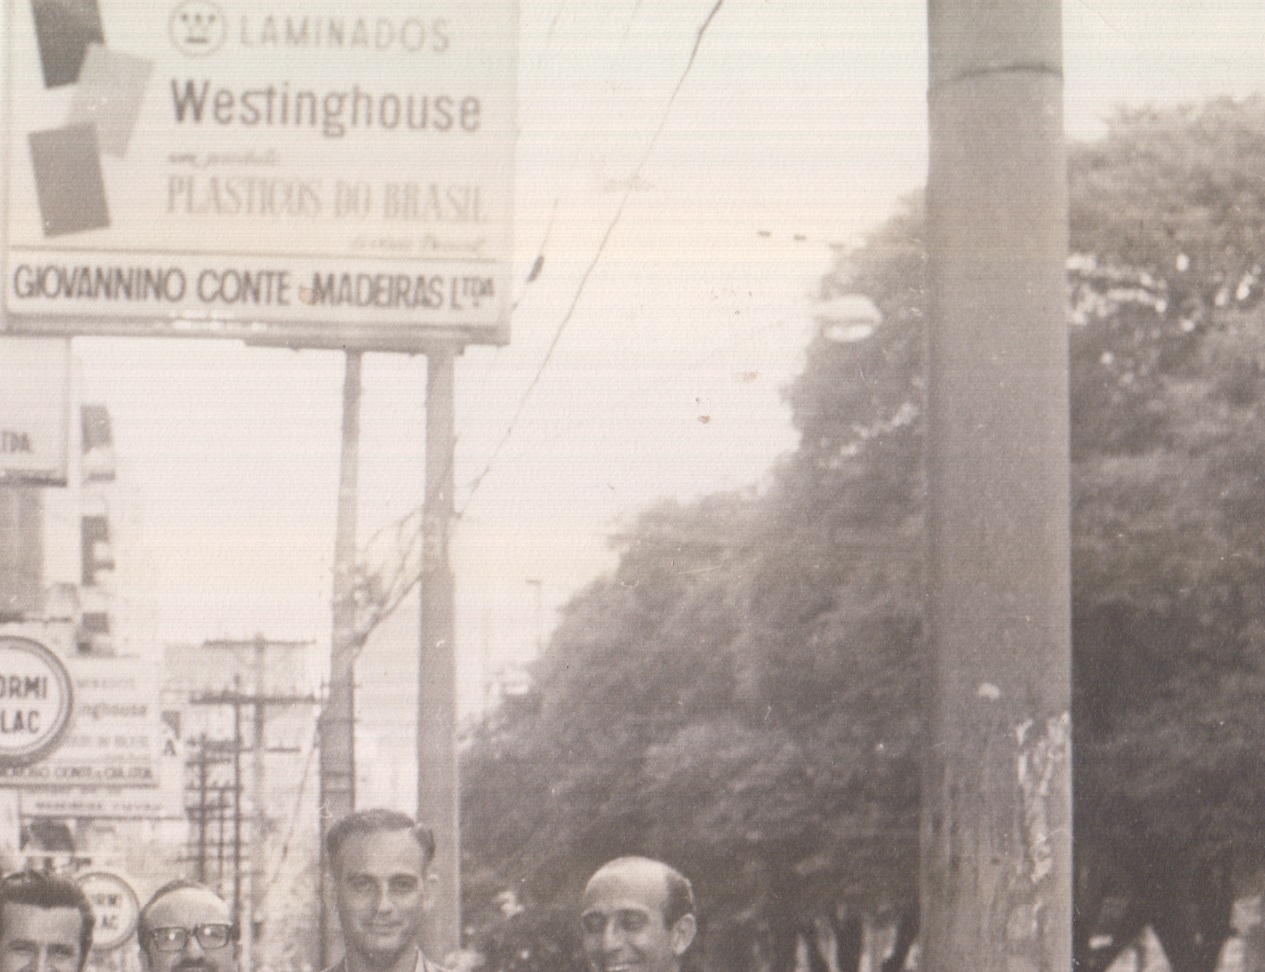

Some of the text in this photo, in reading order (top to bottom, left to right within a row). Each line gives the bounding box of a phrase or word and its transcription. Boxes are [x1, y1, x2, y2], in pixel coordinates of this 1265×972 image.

[239, 12, 450, 53] LAMINADOS
[170, 78, 482, 139] Westinghouse
[334, 179, 372, 220] DO
[383, 180, 488, 223] BRASIL
[13, 264, 187, 302] GIOVANNINO
[196, 267, 292, 305] CONTE
[311, 271, 444, 310] MADEIRAS
